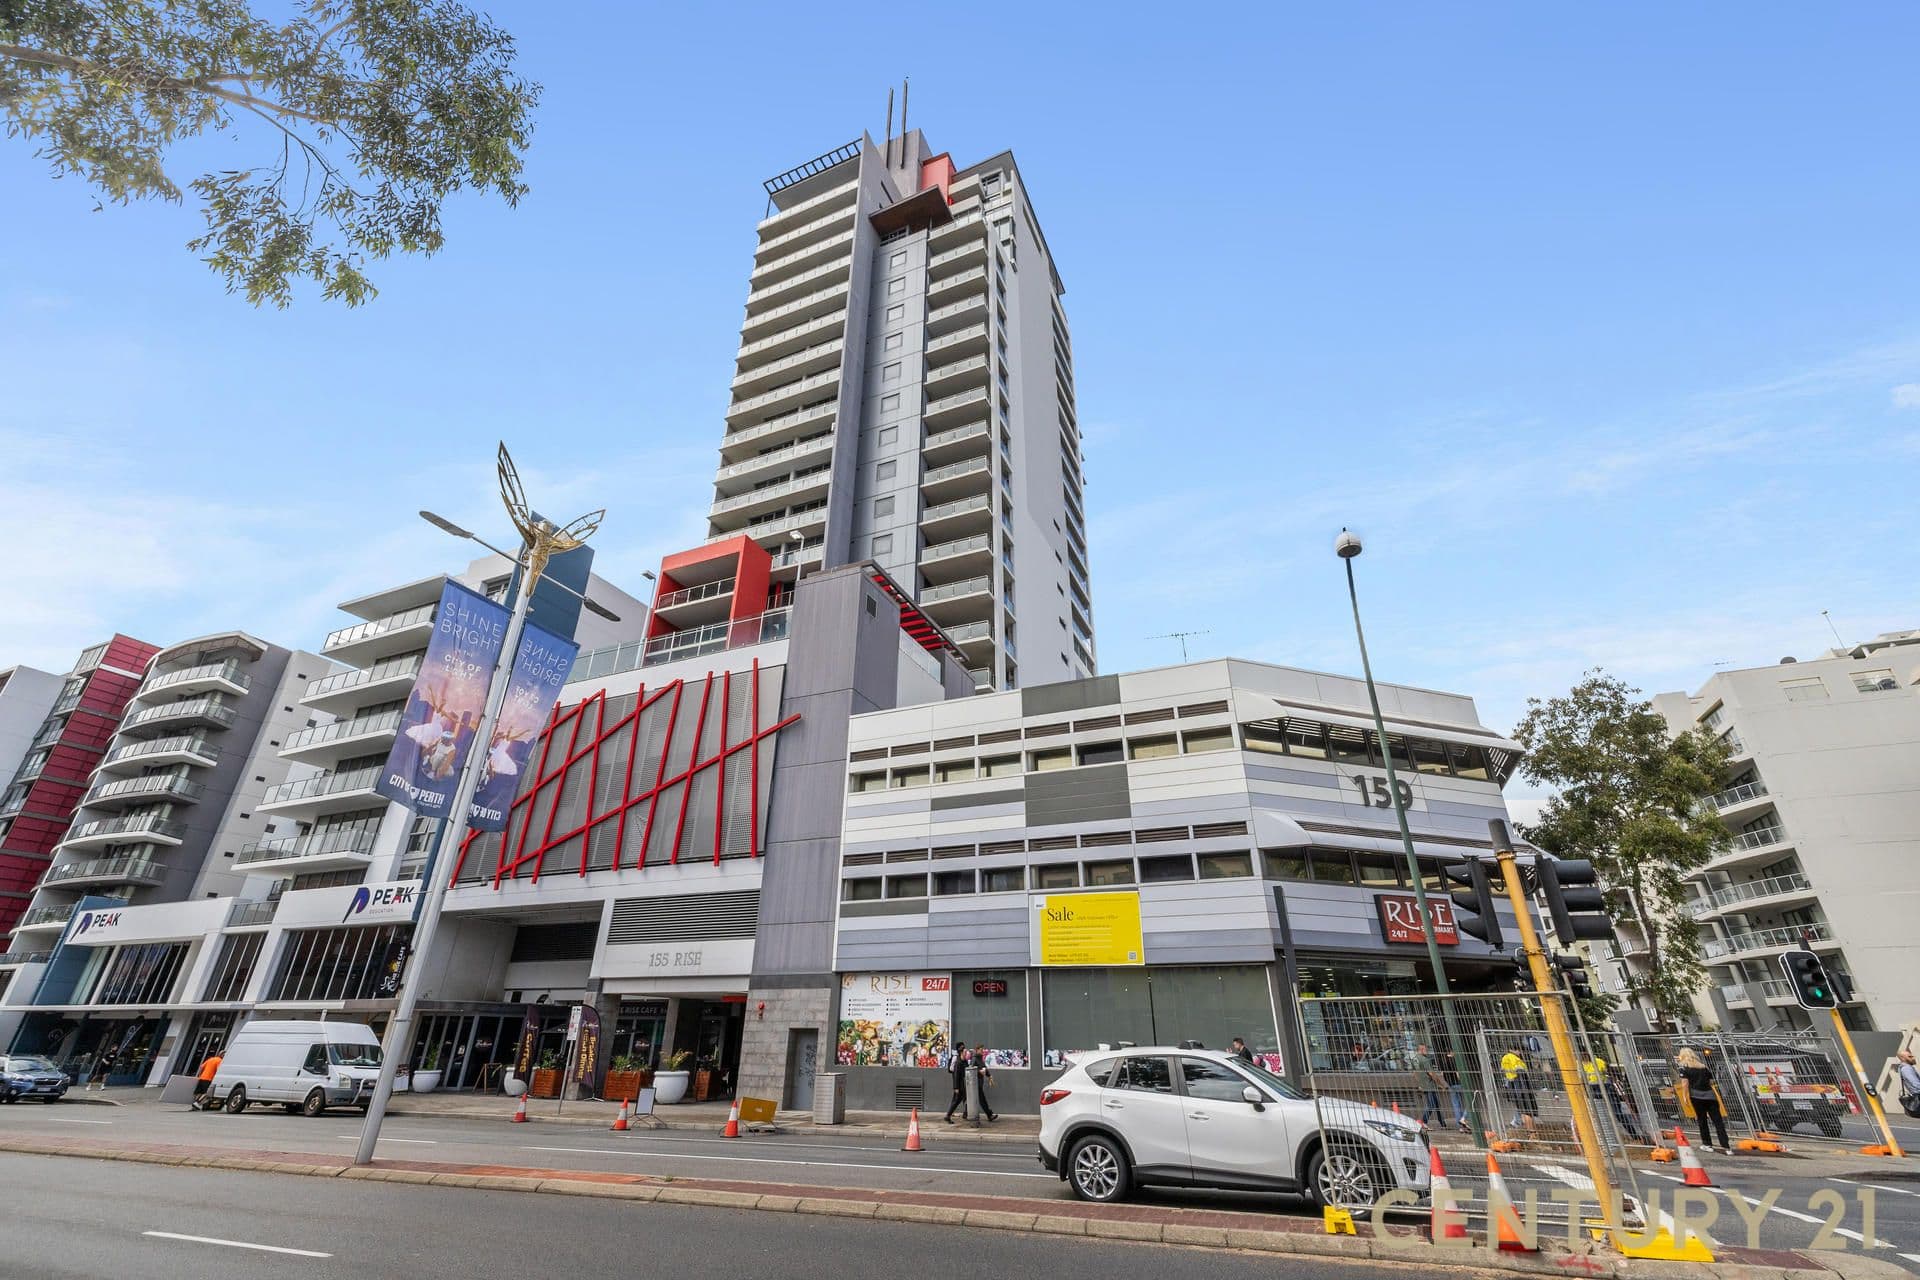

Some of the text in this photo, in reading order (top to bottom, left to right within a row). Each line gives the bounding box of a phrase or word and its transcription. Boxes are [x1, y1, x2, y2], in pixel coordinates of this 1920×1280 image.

[445, 602, 502, 638] SHINE
[440, 618, 499, 652] BRIGHT
[467, 663, 483, 673] OF
[389, 774, 405, 789] CITY
[418, 789, 446, 805] PERTH
[1354, 774, 1413, 811] 159
[372, 886, 415, 905] PEAK
[92, 912, 122, 928] PEAK
[1047, 906, 1074, 922] Sale
[648, 951, 703, 967] 155 RISE
[871, 975, 913, 993] RISE
[926, 978, 947, 990] 24/7
[975, 982, 1004, 993] OPEN
